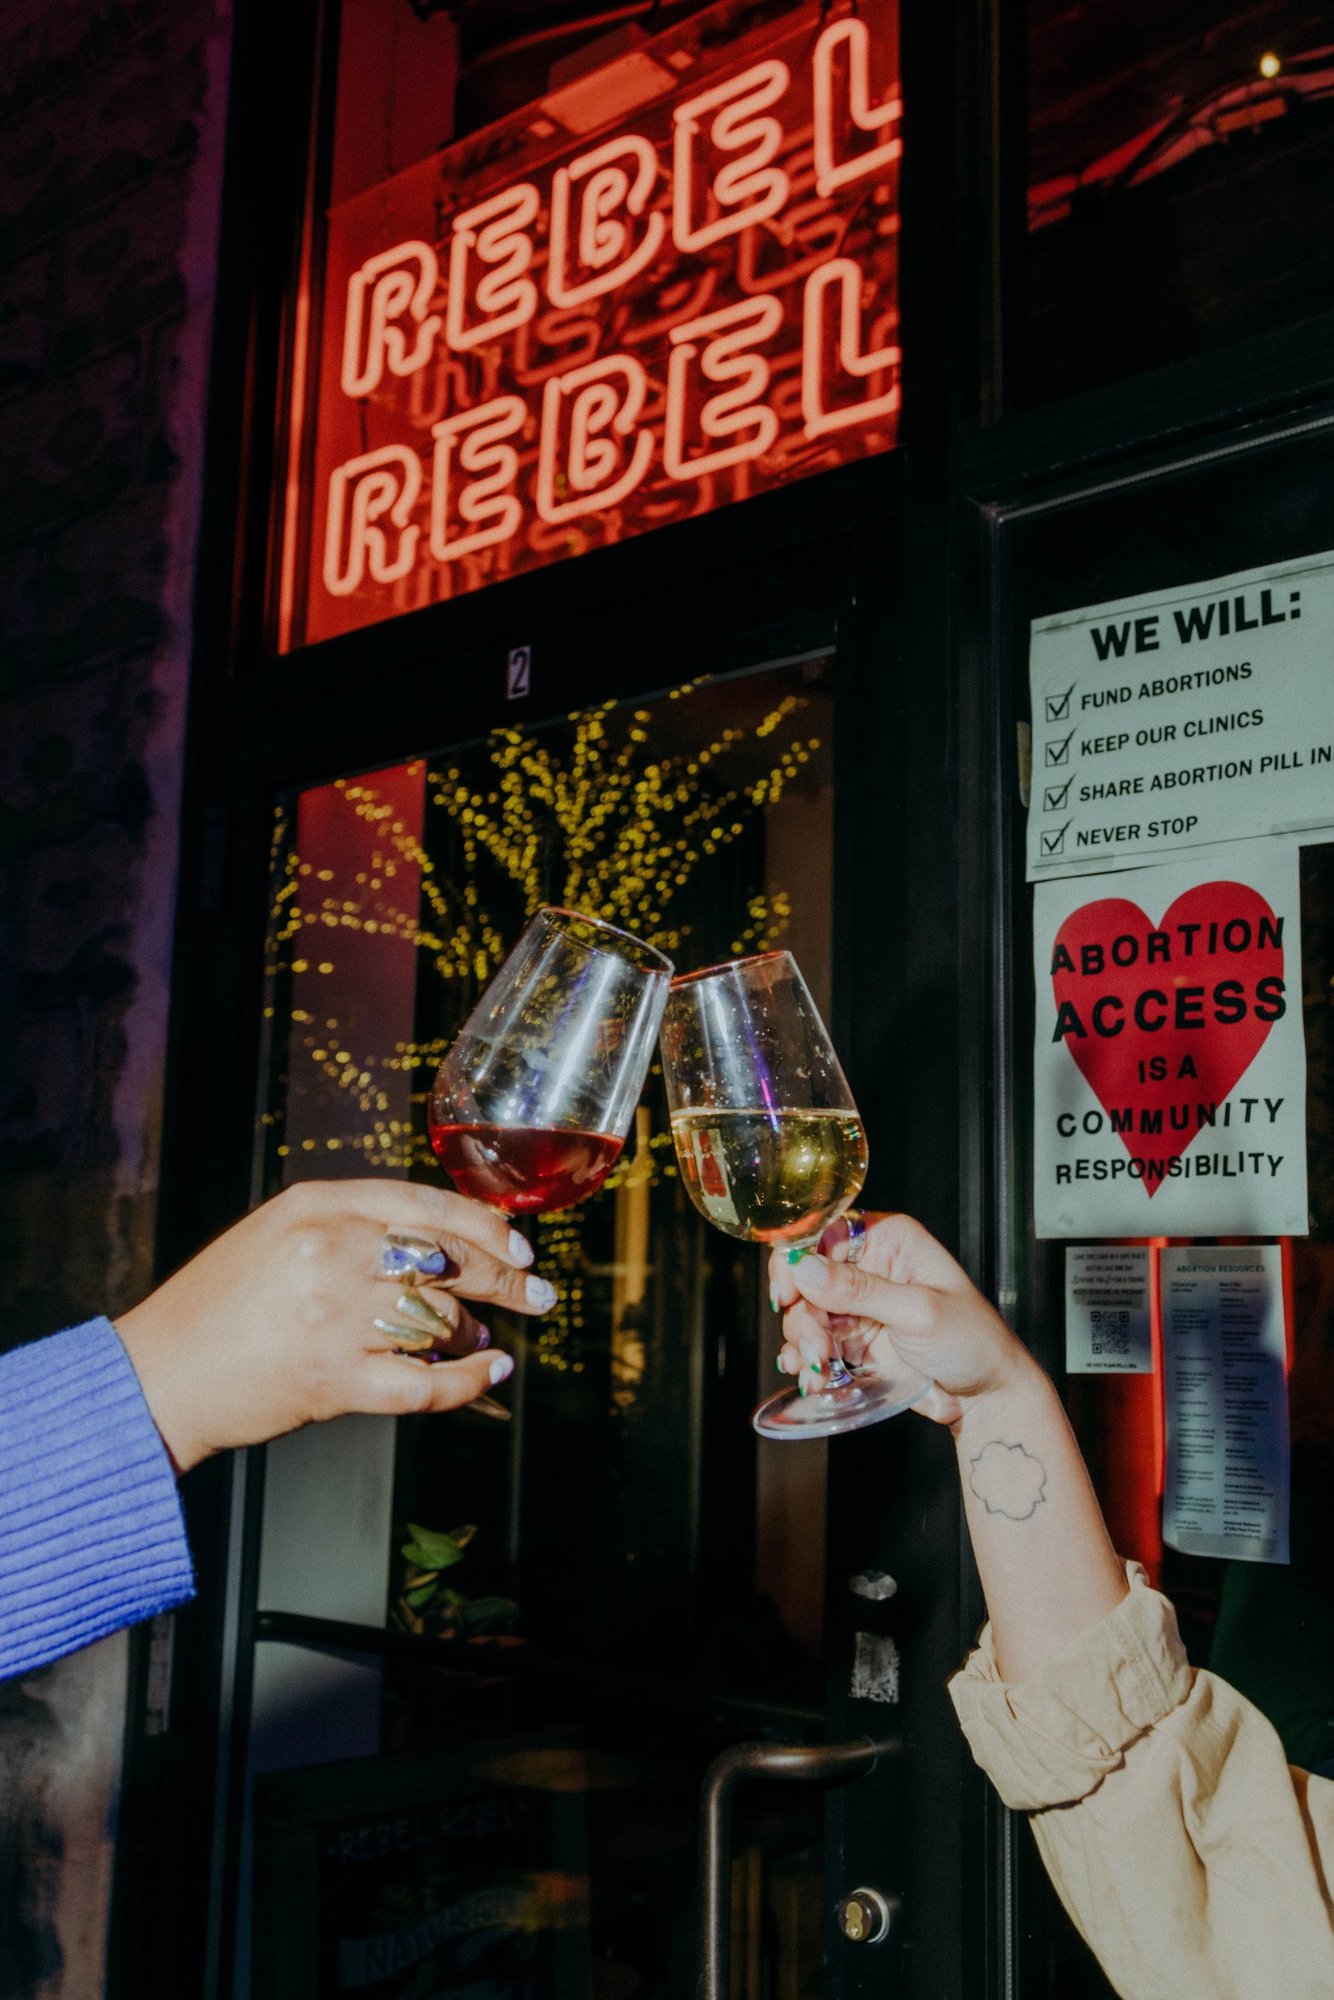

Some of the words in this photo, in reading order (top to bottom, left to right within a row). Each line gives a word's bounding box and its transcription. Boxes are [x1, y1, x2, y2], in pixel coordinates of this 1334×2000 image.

[341, 17, 901, 398] REBEL
[322, 256, 901, 596] REBEL
[1090, 615, 1160, 661] WE
[1173, 589, 1301, 644] WILL:
[512, 651, 527, 694] 2
[1081, 687, 1132, 711] FUND
[1138, 662, 1253, 699] ABORTIONS
[1081, 733, 1130, 756] KEEP
[1135, 725, 1177, 747] OUR
[1183, 709, 1264, 738] CLINICS
[1079, 777, 1145, 802] SHARE
[1150, 759, 1253, 792] ABORTION
[1260, 751, 1303, 773] PILL
[1076, 823, 1141, 847] NEVER
[1147, 815, 1198, 838] STOP
[1050, 917, 1285, 976] ABORTION
[1052, 976, 1287, 1043] ACCESS
[1139, 1056, 1168, 1083] IS
[1177, 1055, 1198, 1079] A
[1056, 1098, 1285, 1138] COMMUNITY
[1056, 1151, 1285, 1184] RESPONSIBILITY
